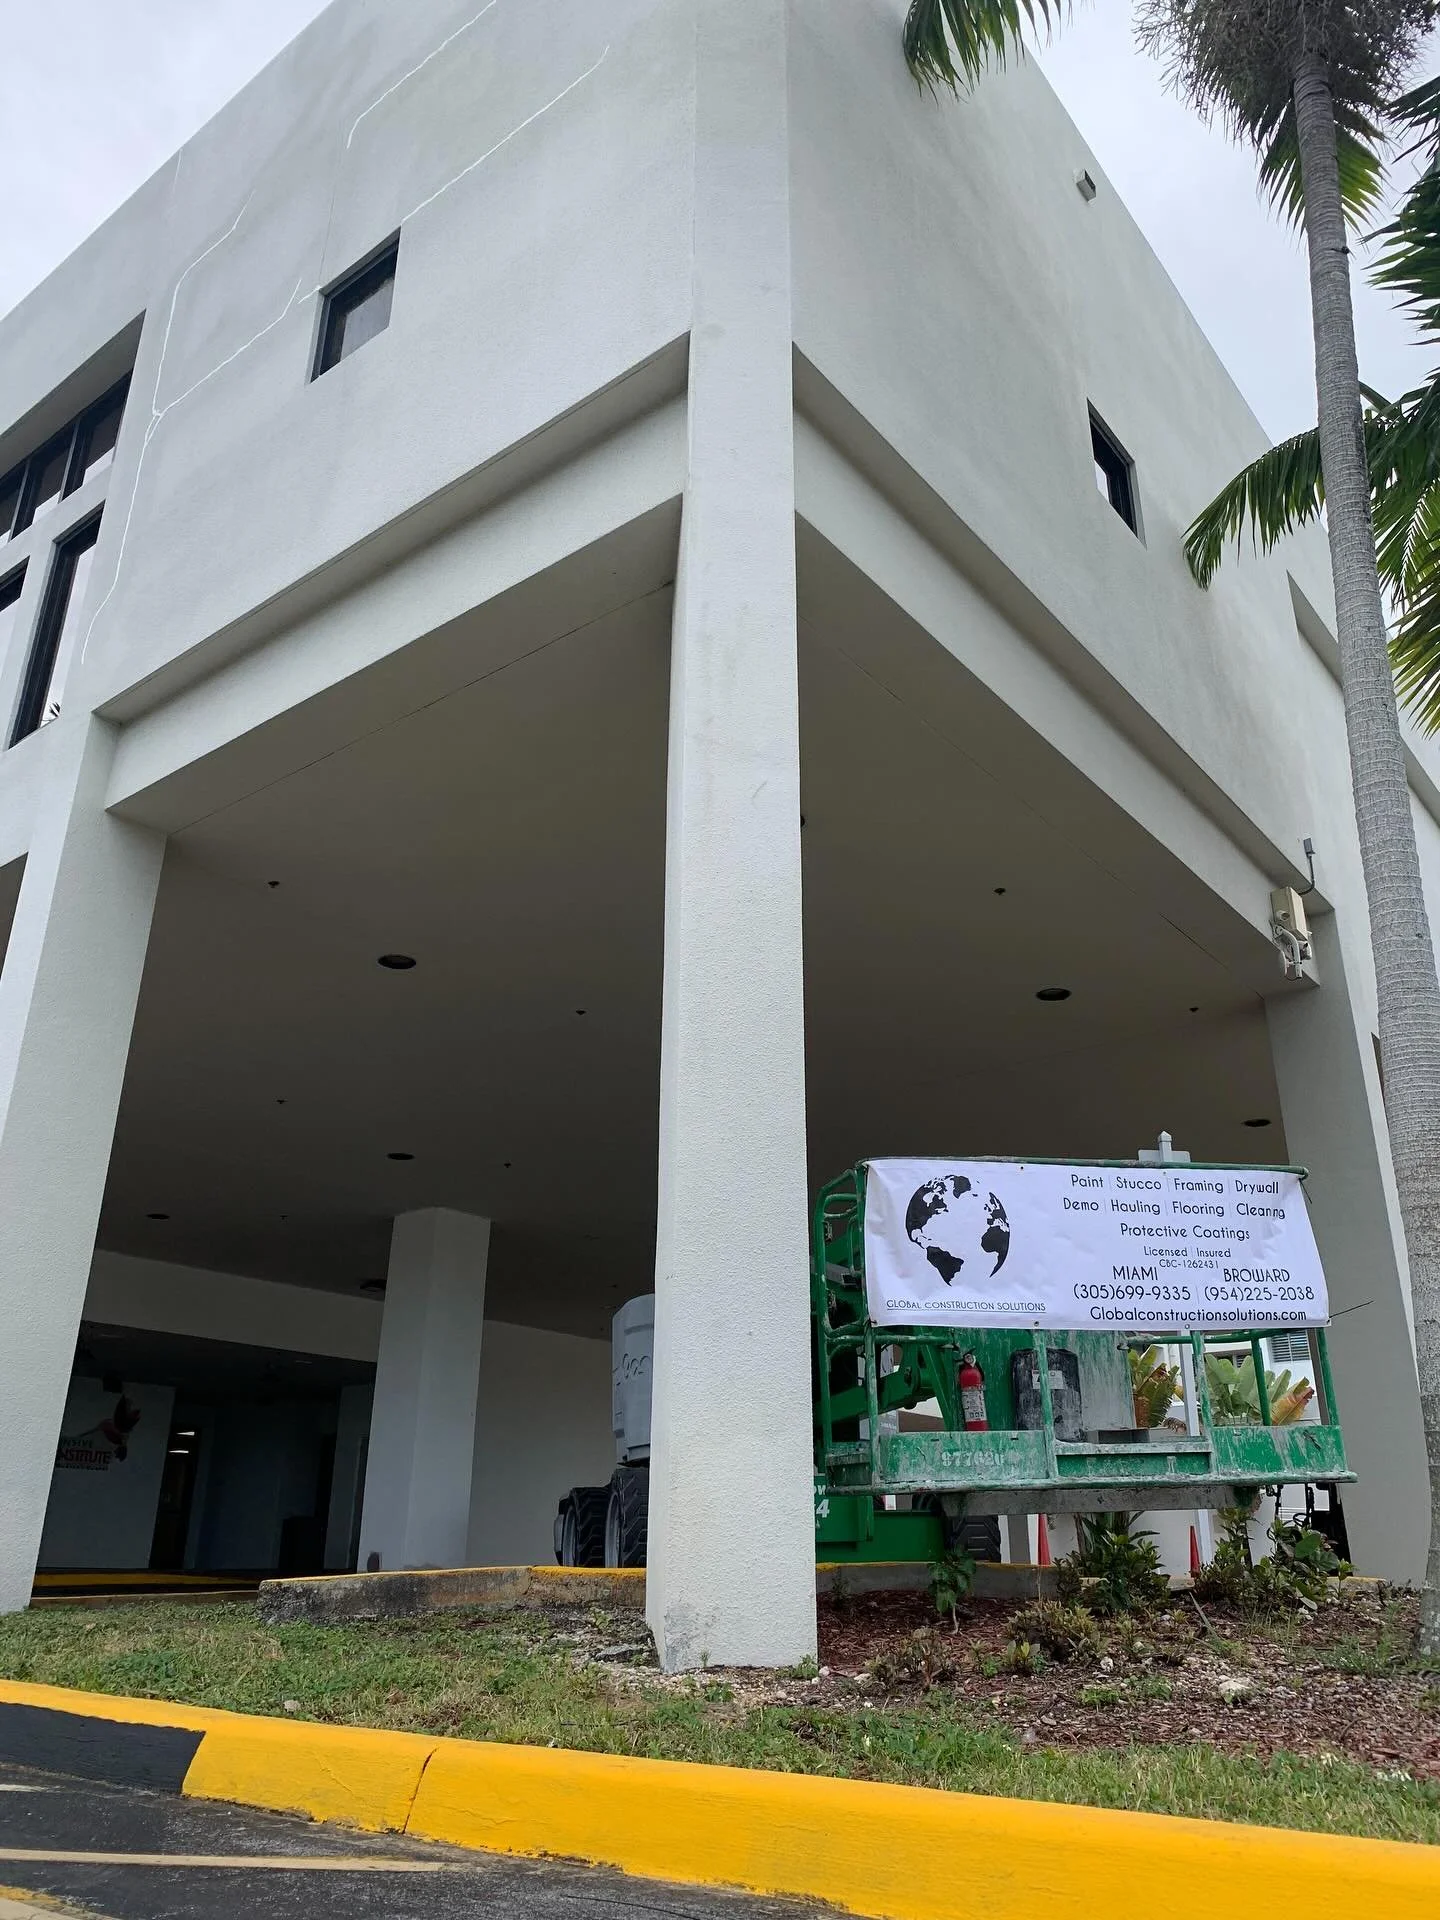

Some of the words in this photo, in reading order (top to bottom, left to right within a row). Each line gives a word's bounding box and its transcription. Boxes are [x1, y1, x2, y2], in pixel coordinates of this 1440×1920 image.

[1071, 1174, 1104, 1188] Paint
[1116, 1176, 1162, 1190] Stucco
[1174, 1178, 1224, 1194] Framing
[1235, 1180, 1279, 1195] Drywall
[1063, 1197, 1099, 1212] Demo
[1111, 1199, 1161, 1215] Hauling
[1173, 1201, 1224, 1217] Flooring
[1120, 1223, 1187, 1238] Protective
[1193, 1225, 1250, 1241] Coatings
[1143, 1245, 1188, 1257] Licensed
[1196, 1247, 1231, 1258] Insured
[1112, 1265, 1159, 1281] MIAMI
[1223, 1268, 1290, 1283] BROWARD
[1073, 1283, 1191, 1301] (305)699-9335
[1204, 1285, 1315, 1302] (954)225-2038
[886, 1299, 921, 1309] GLOBAL
[924, 1301, 995, 1311] CONSTRUCTION
[997, 1302, 1046, 1312] SOLUTIONS
[1090, 1306, 1307, 1322] Globalconstructionsolutions.com
